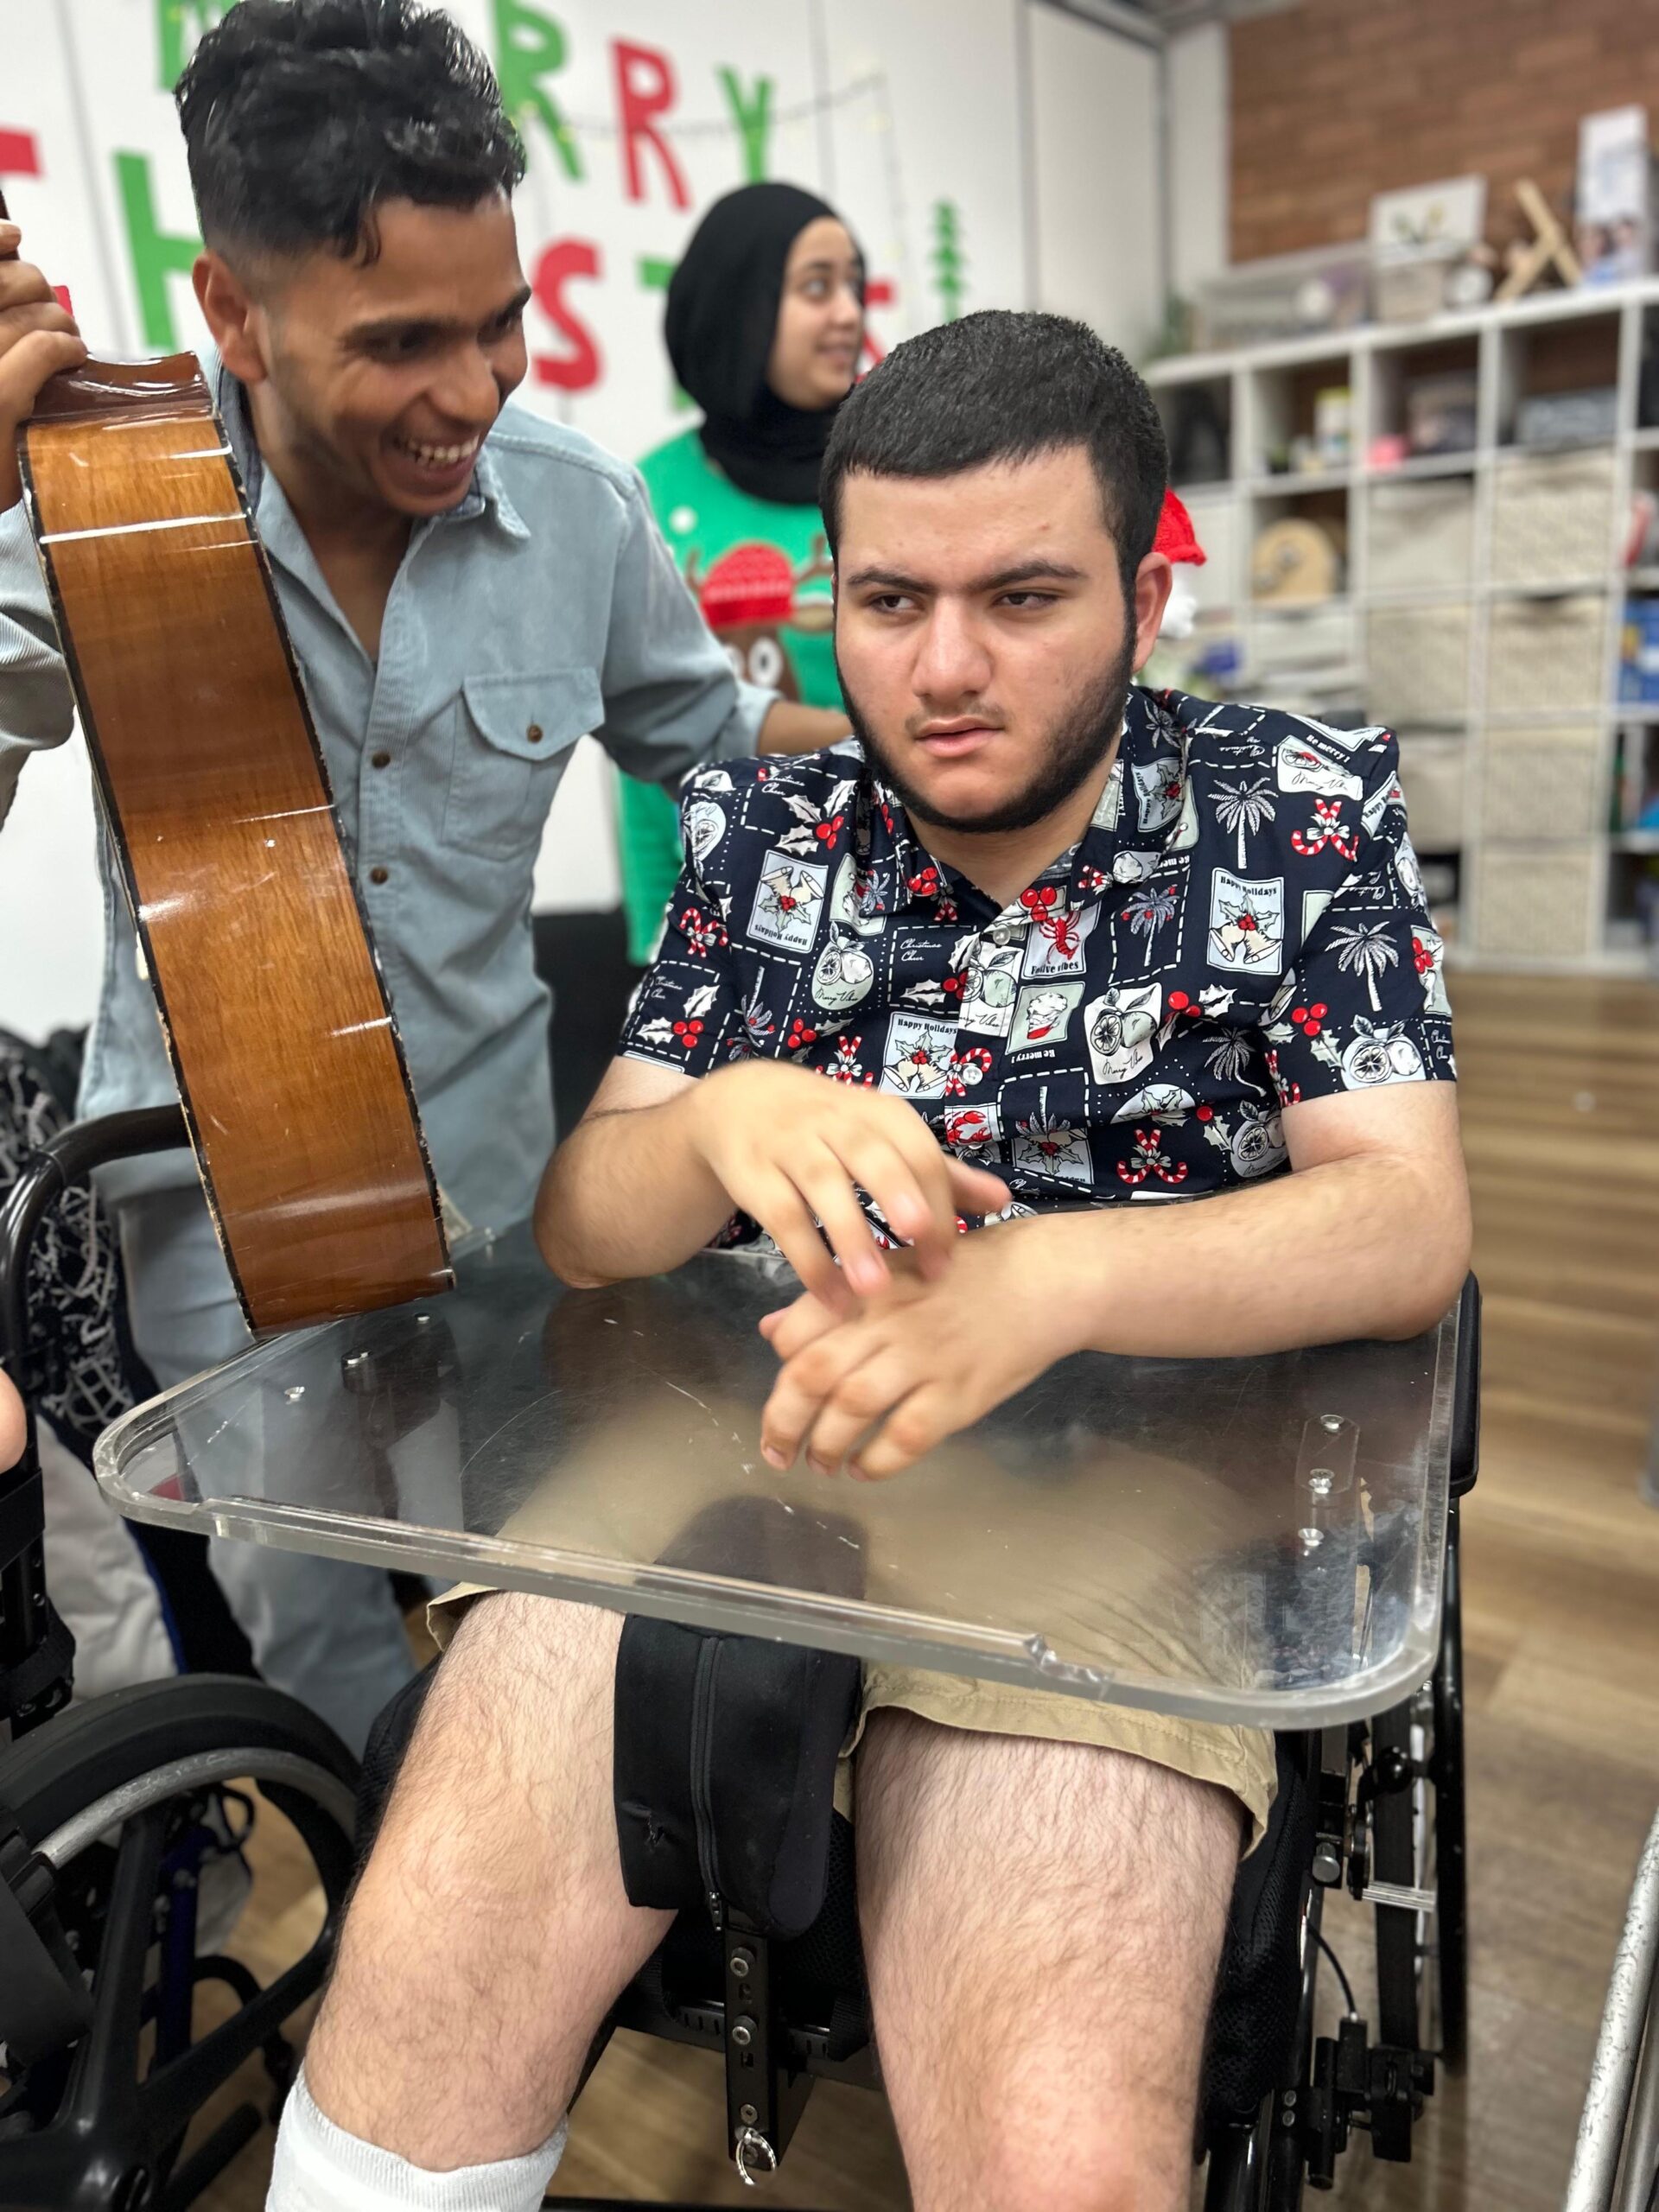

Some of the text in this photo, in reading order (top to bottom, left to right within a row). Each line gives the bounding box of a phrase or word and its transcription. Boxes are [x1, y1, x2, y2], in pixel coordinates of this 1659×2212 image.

[899, 938, 942, 950] Christmas
[900, 950, 925, 962] Cheer
[898, 1018, 958, 1035] Happy Holidays
